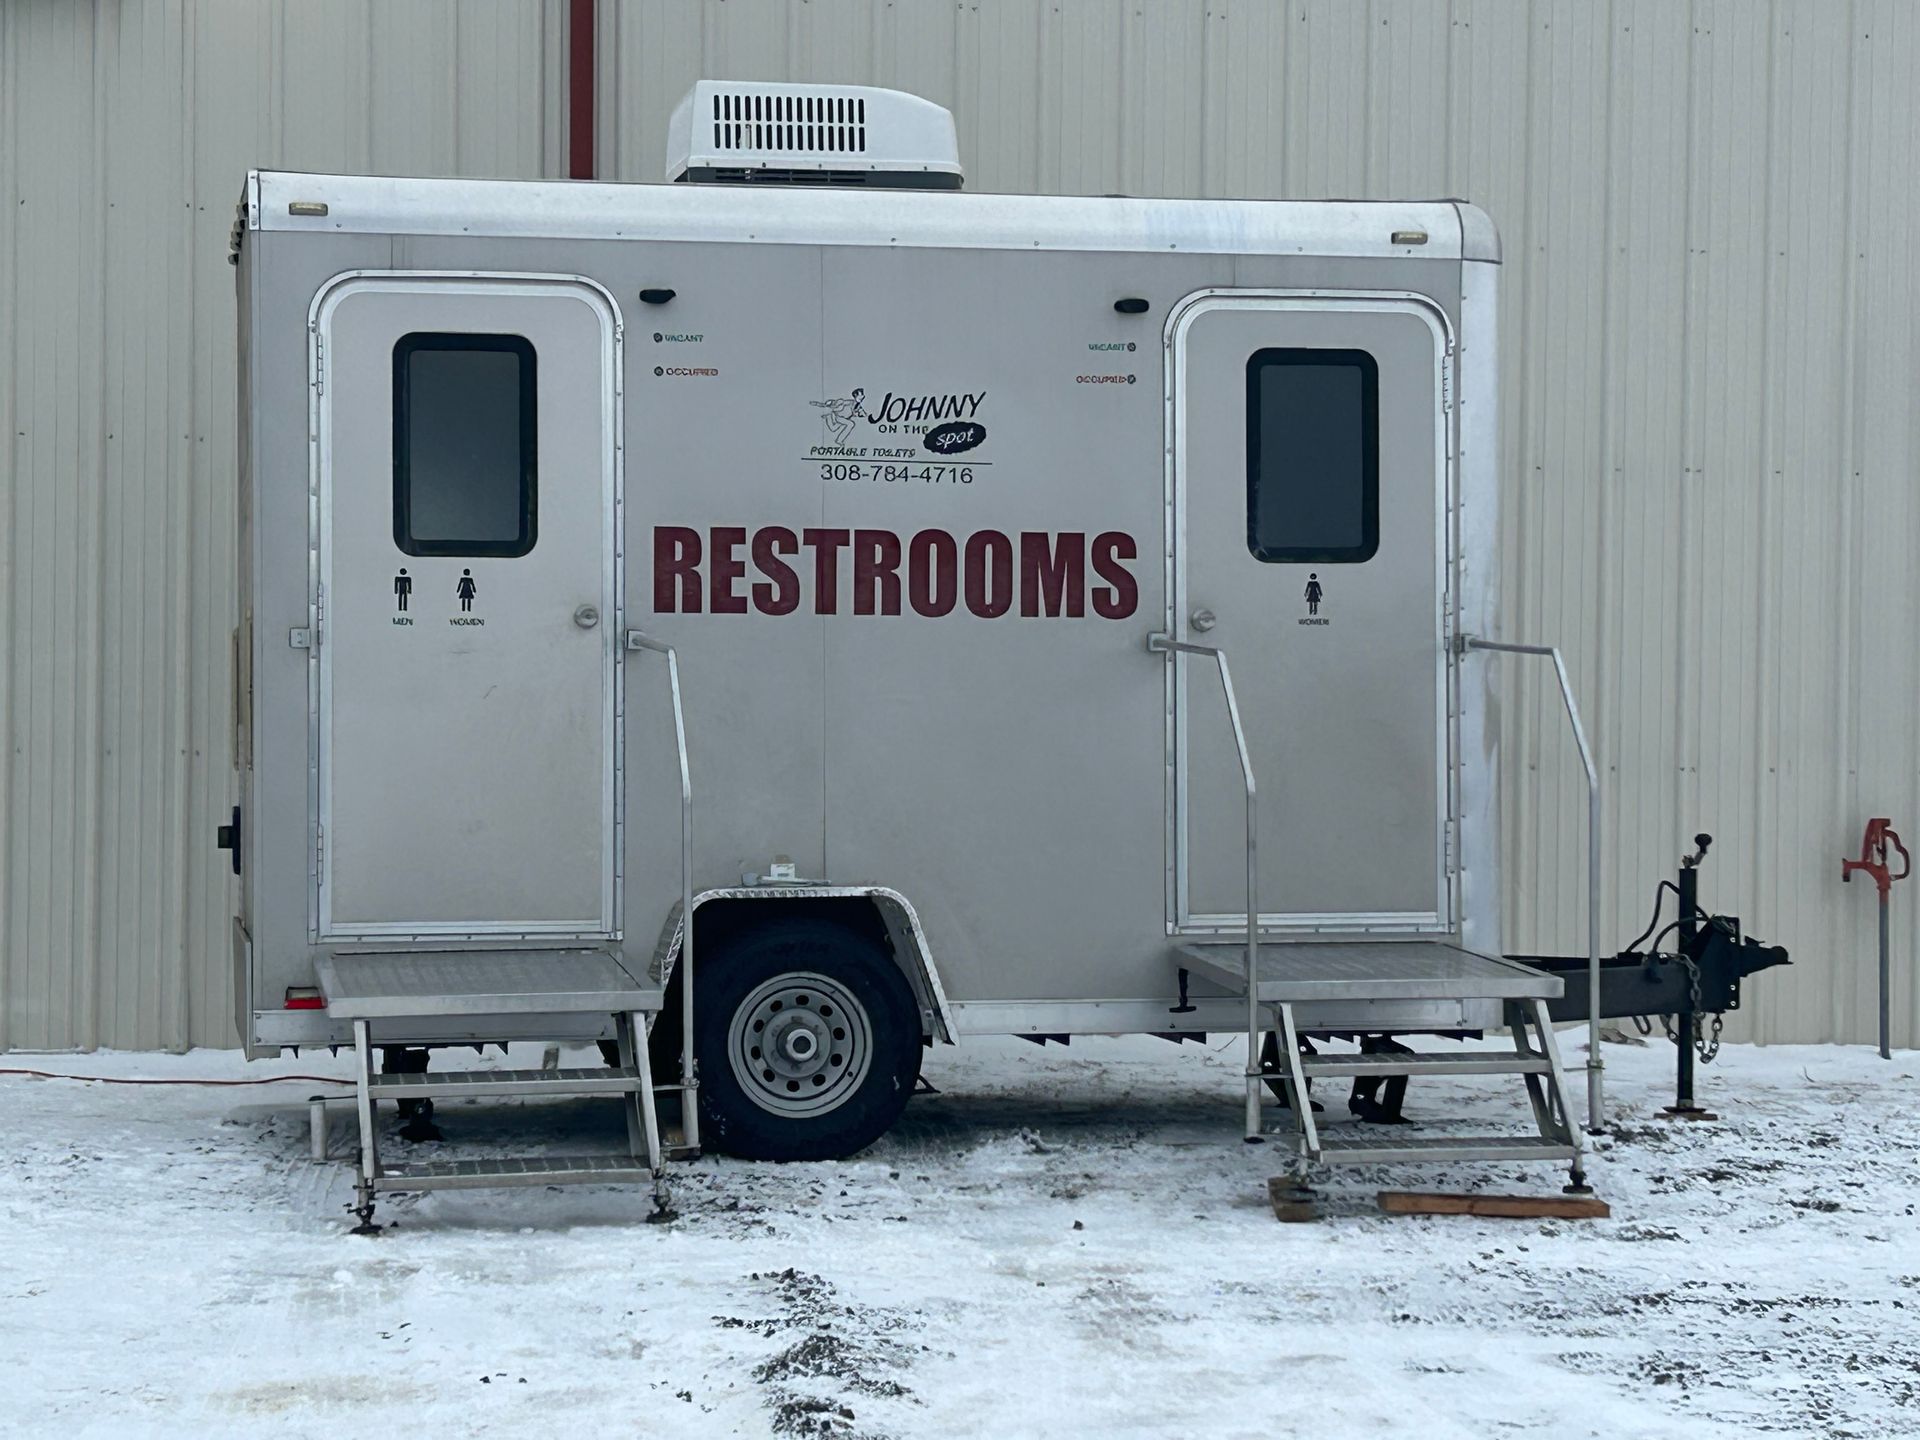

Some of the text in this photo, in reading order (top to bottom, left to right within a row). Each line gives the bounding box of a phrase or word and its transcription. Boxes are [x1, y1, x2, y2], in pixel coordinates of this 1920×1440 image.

[867, 391, 987, 424] JOHNNY
[878, 424, 929, 434] ON THE
[935, 429, 975, 449] spot
[810, 446, 916, 458] PORTABLE TOILETS
[820, 464, 974, 484] 308-784-4716
[653, 525, 1139, 620] RESTROOMS
